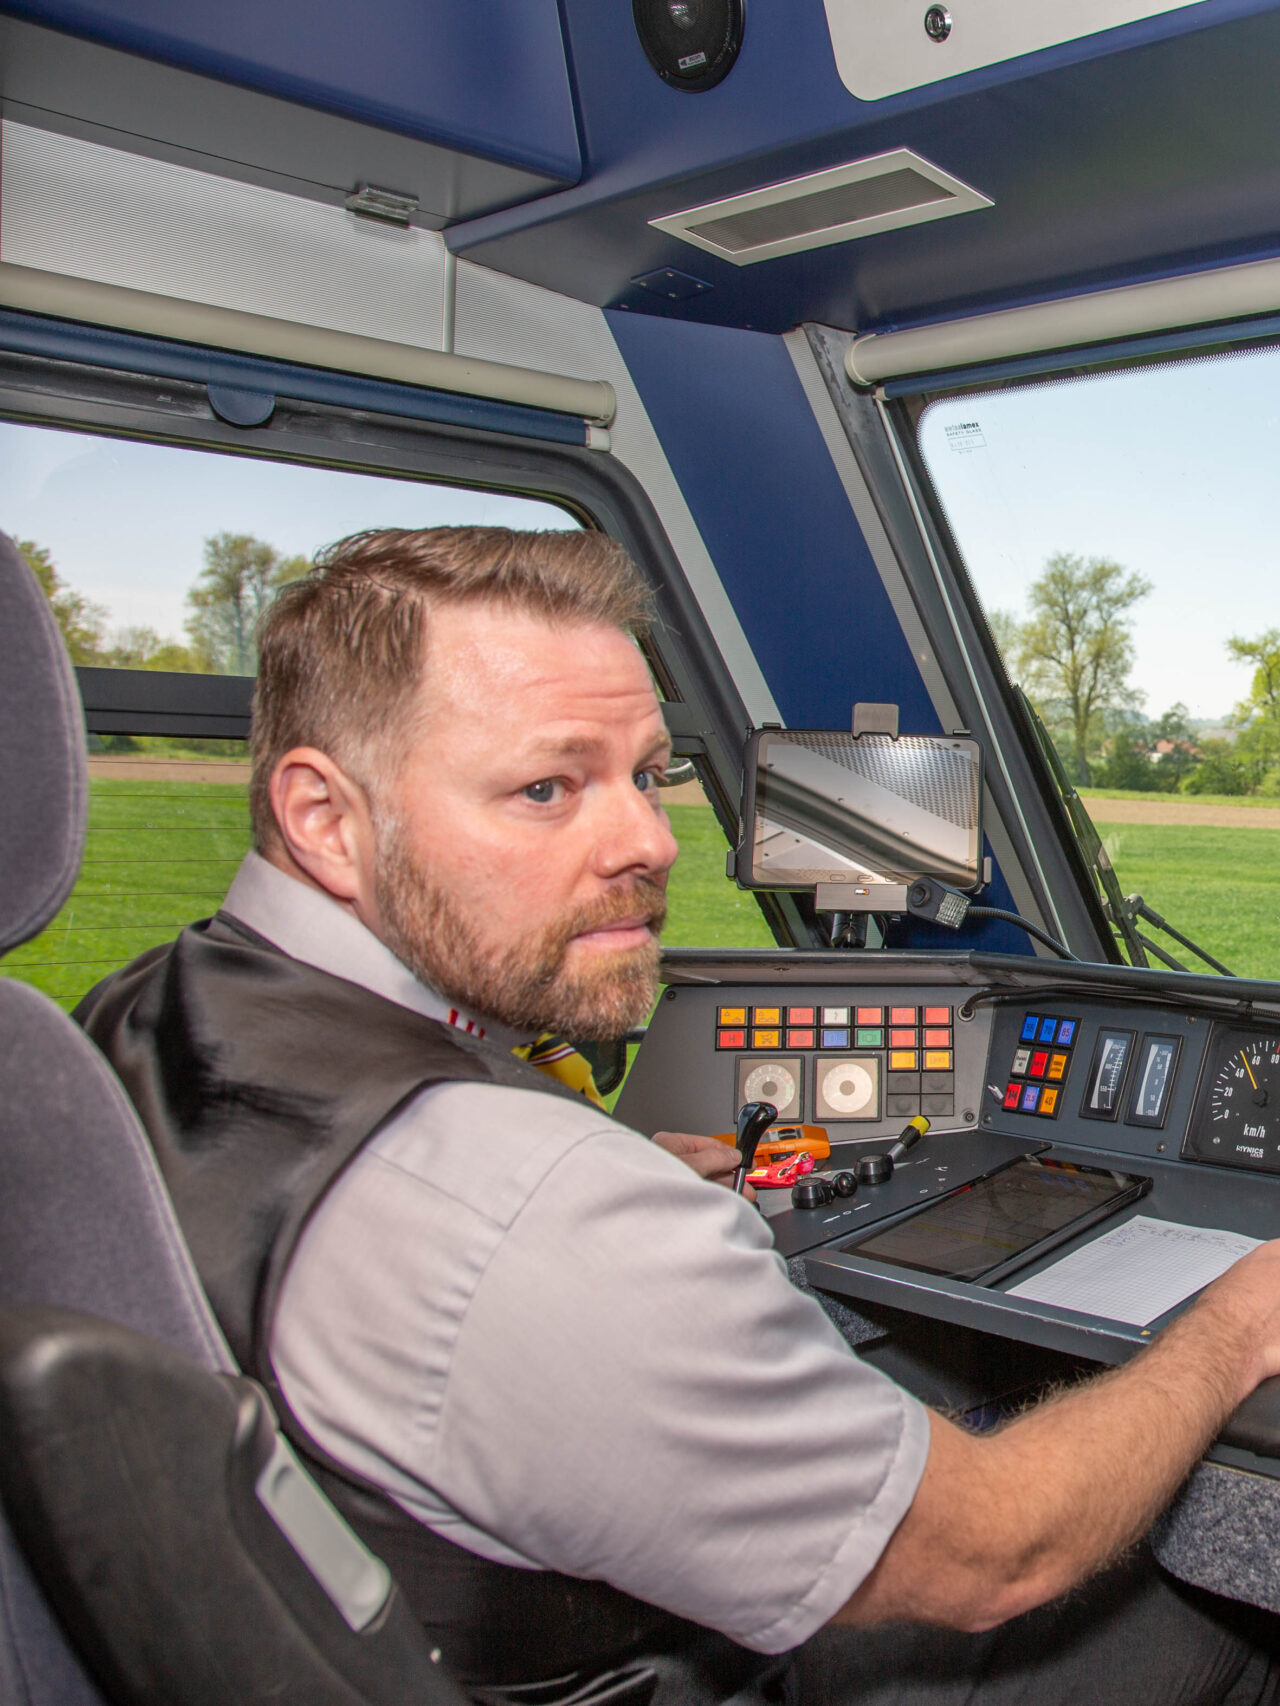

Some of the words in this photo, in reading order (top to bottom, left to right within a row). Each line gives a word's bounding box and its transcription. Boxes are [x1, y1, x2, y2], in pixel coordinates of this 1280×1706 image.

[1252, 1055, 1261, 1065] 60
[1271, 1054, 1279, 1064] 80
[1235, 1068, 1245, 1078] 40
[1224, 1086, 1234, 1097] 20
[1224, 1109, 1230, 1119] 0
[1243, 1123, 1266, 1138] km/h
